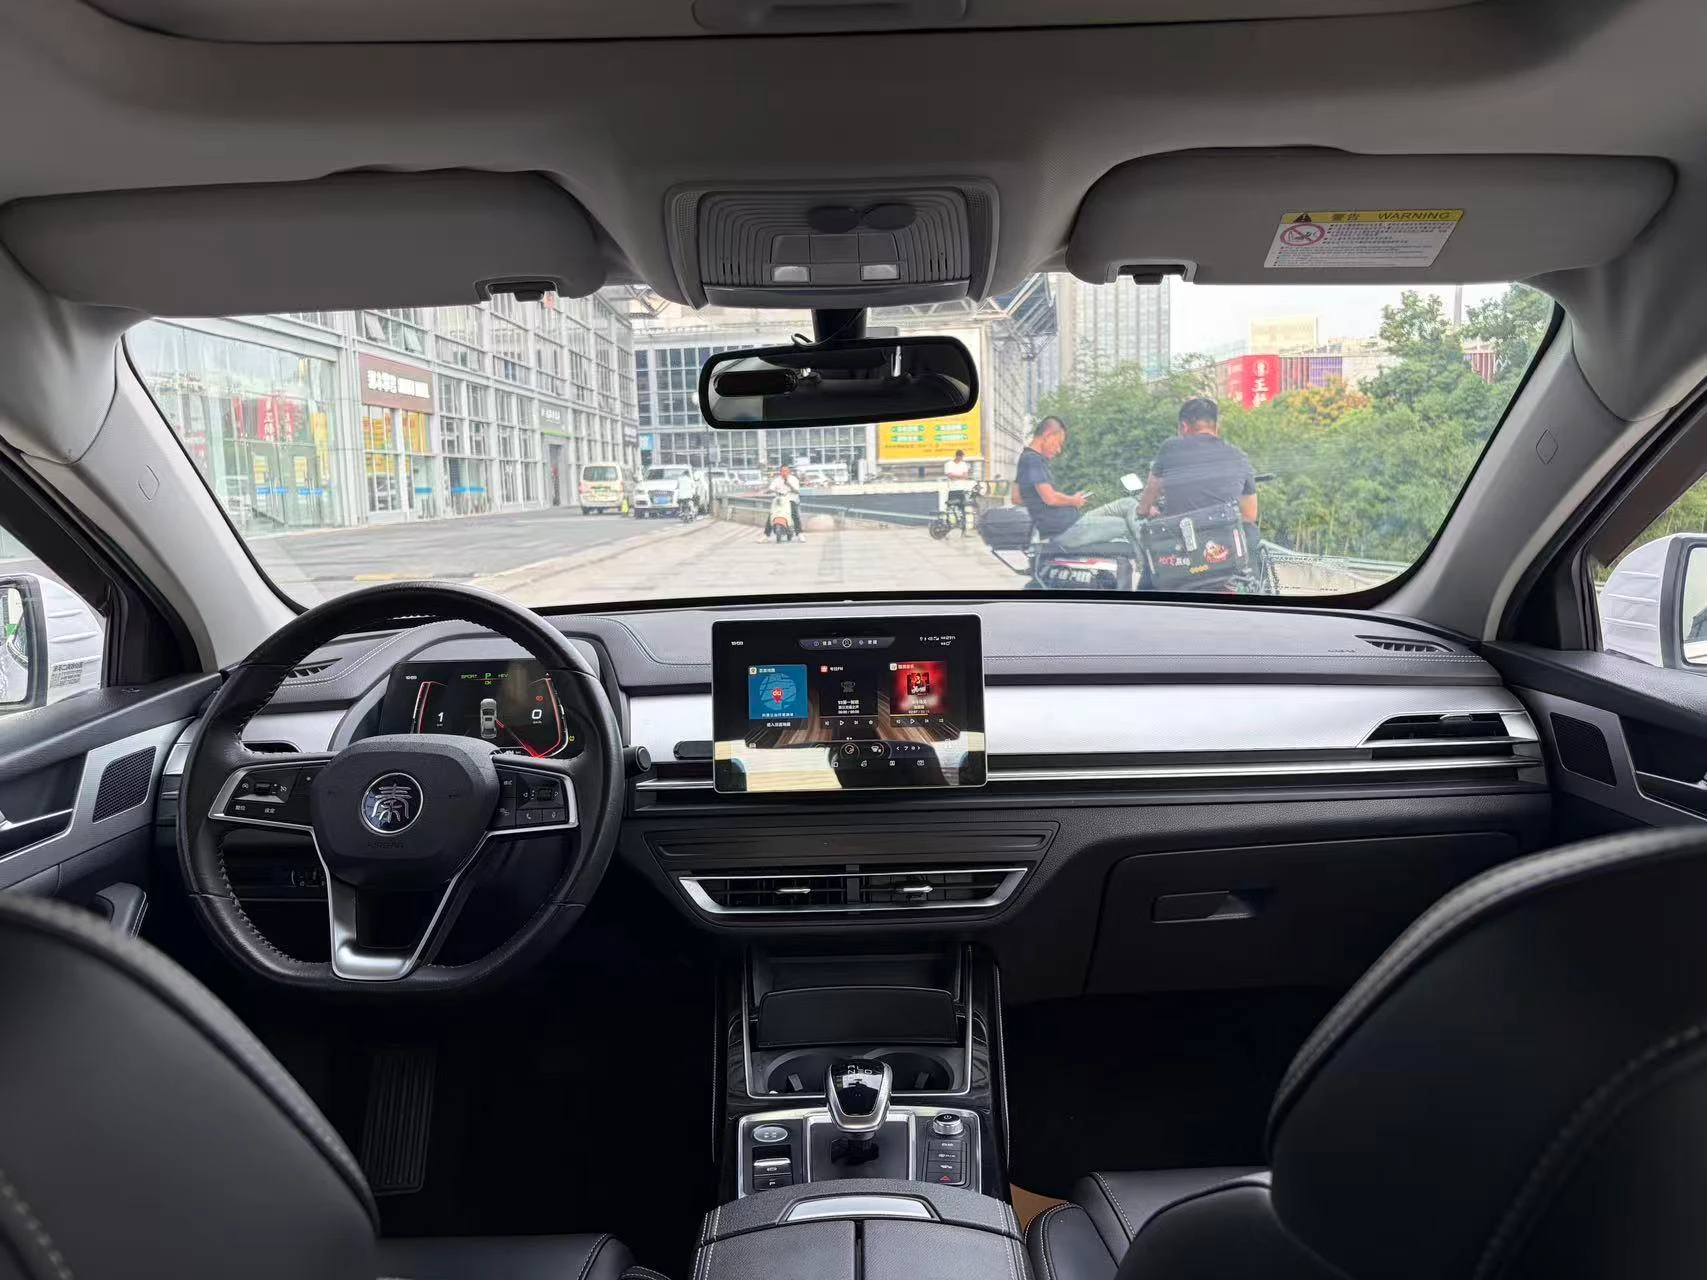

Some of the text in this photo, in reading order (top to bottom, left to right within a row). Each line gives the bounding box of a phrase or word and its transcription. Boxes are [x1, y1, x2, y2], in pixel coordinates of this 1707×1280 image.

[1378, 211, 1451, 221] WARNING
[437, 711, 444, 722] 1
[531, 709, 543, 720] 0
